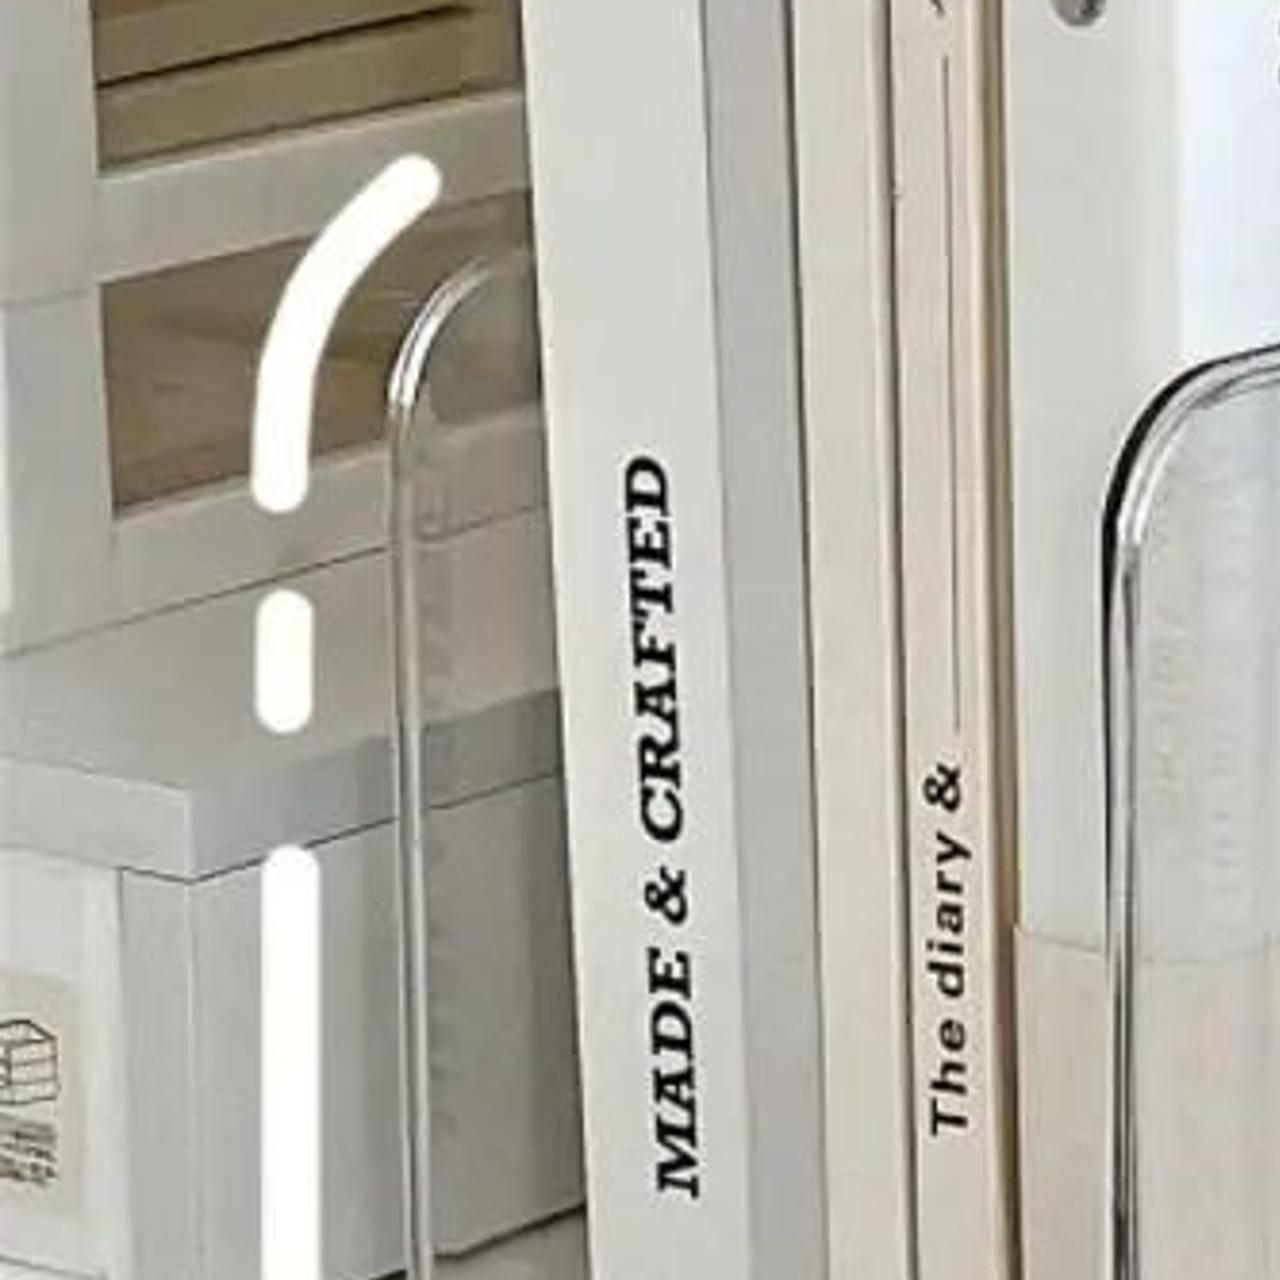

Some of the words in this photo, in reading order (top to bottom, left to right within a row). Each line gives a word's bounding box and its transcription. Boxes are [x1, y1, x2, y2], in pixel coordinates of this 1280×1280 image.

[623, 455, 683, 844] CRAFTED
[922, 762, 963, 813] &
[643, 864, 690, 926] &
[925, 829, 973, 999] diary
[645, 945, 701, 1200] MADE
[928, 1017, 969, 1138] The
